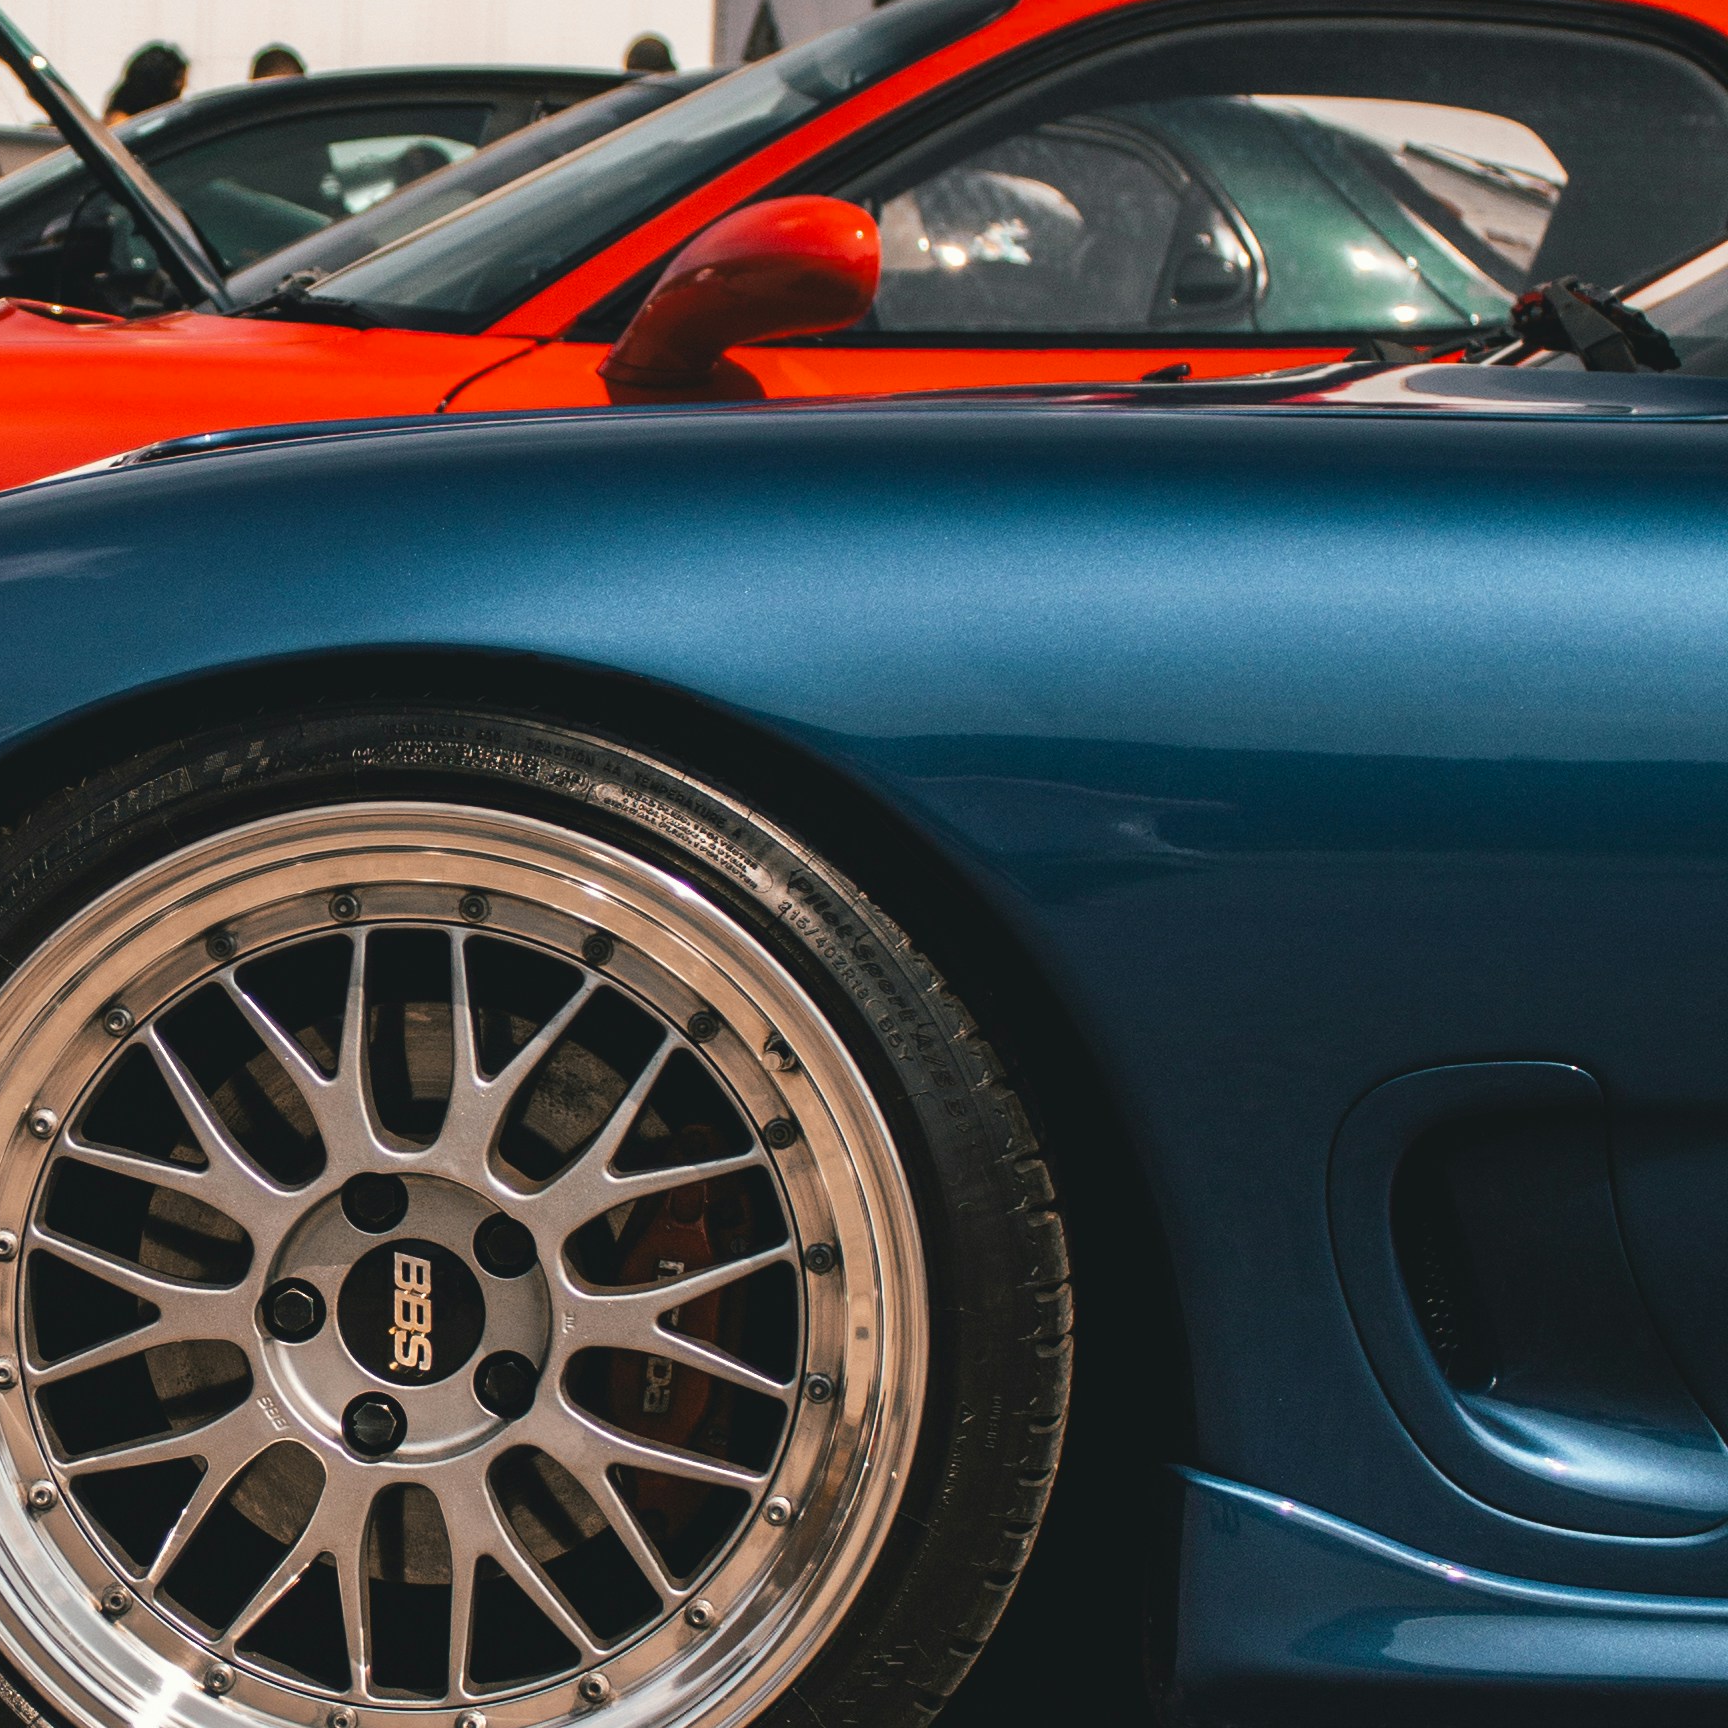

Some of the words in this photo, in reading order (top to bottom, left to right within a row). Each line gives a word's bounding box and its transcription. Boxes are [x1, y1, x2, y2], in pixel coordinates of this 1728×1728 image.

[633, 770, 728, 829] TEMPERATURE
[777, 899, 870, 1001] 215/40ZR18
[787, 873, 854, 939] Pilot
[850, 942, 918, 1024] Sport
[394, 1252, 432, 1372] BBS
[256, 1395, 290, 1431] BBS
